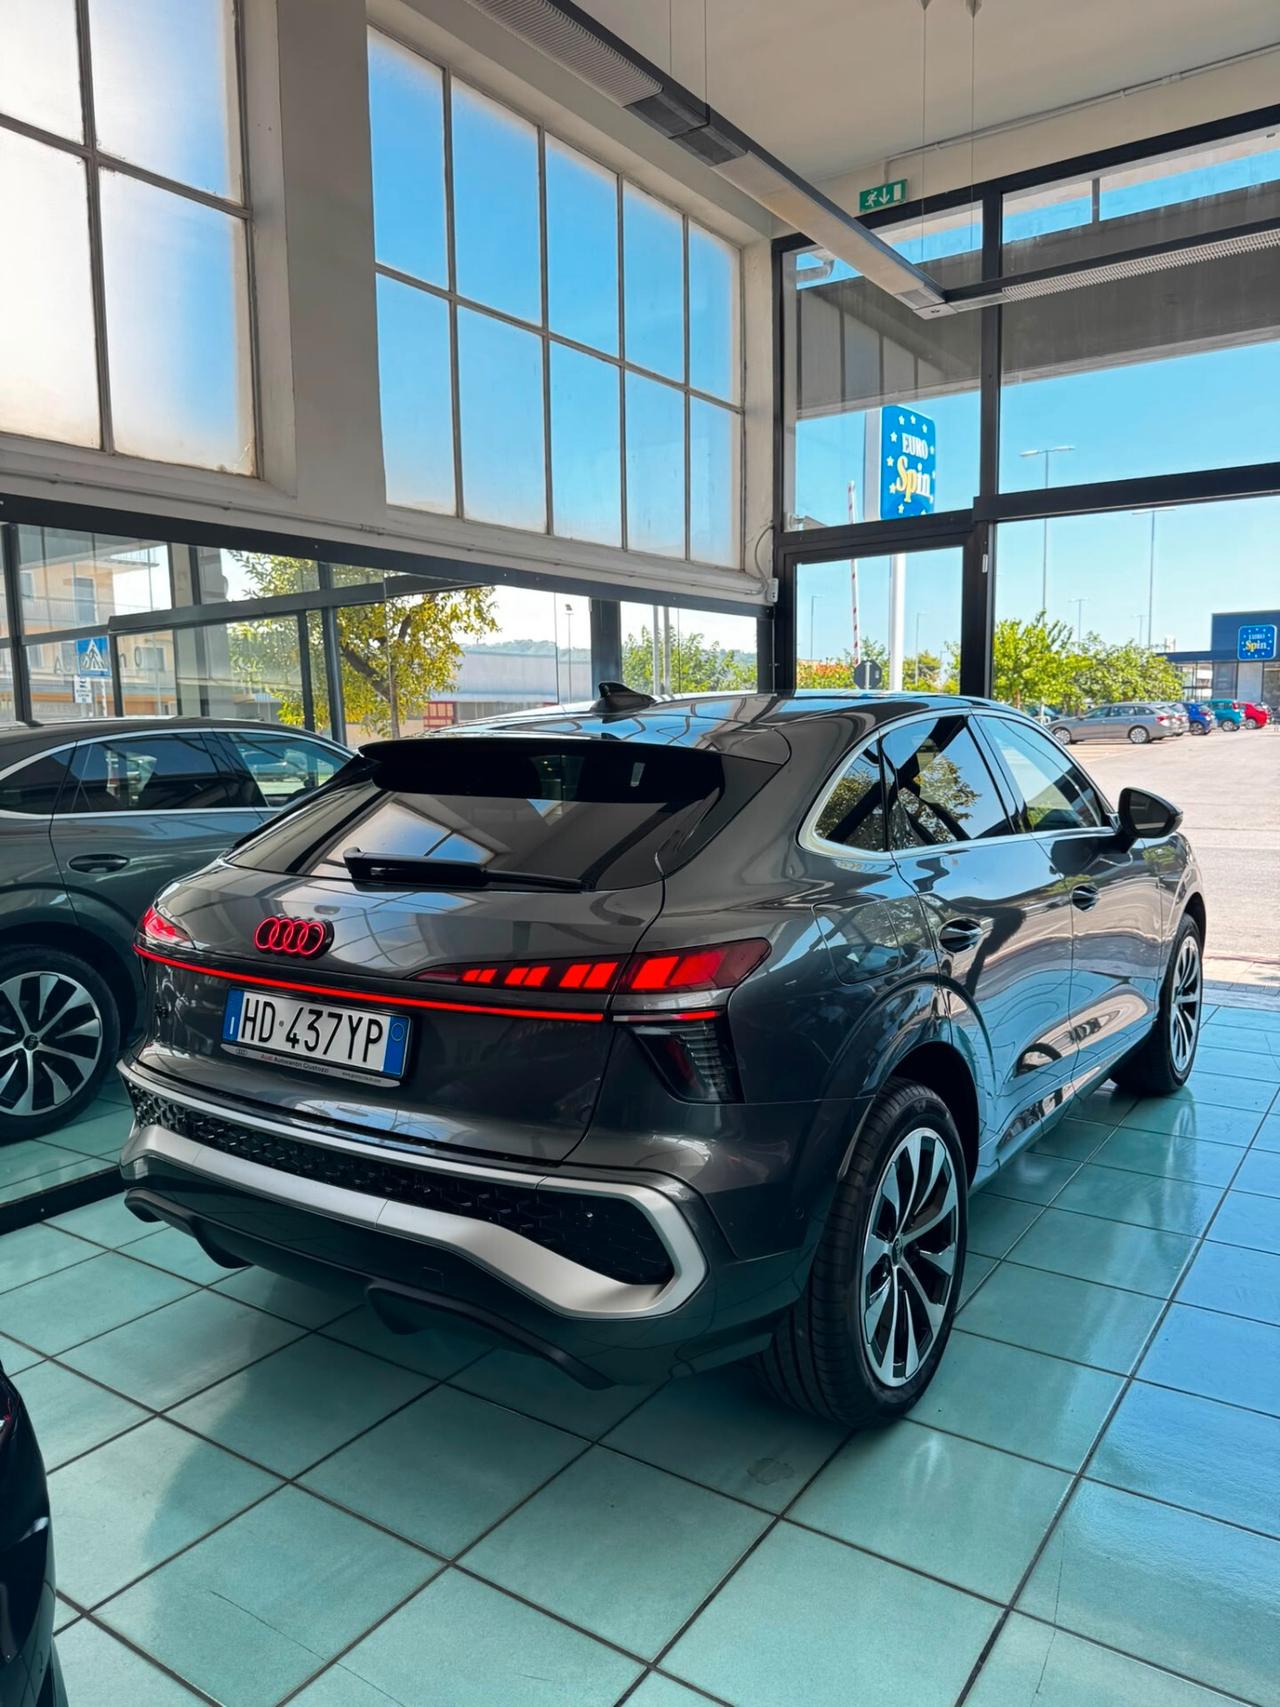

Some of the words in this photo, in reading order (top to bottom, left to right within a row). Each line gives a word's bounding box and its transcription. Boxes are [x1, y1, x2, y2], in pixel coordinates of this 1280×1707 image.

[902, 432, 929, 460] EURO
[896, 455, 931, 503] Spin
[1245, 640, 1268, 652] Spin
